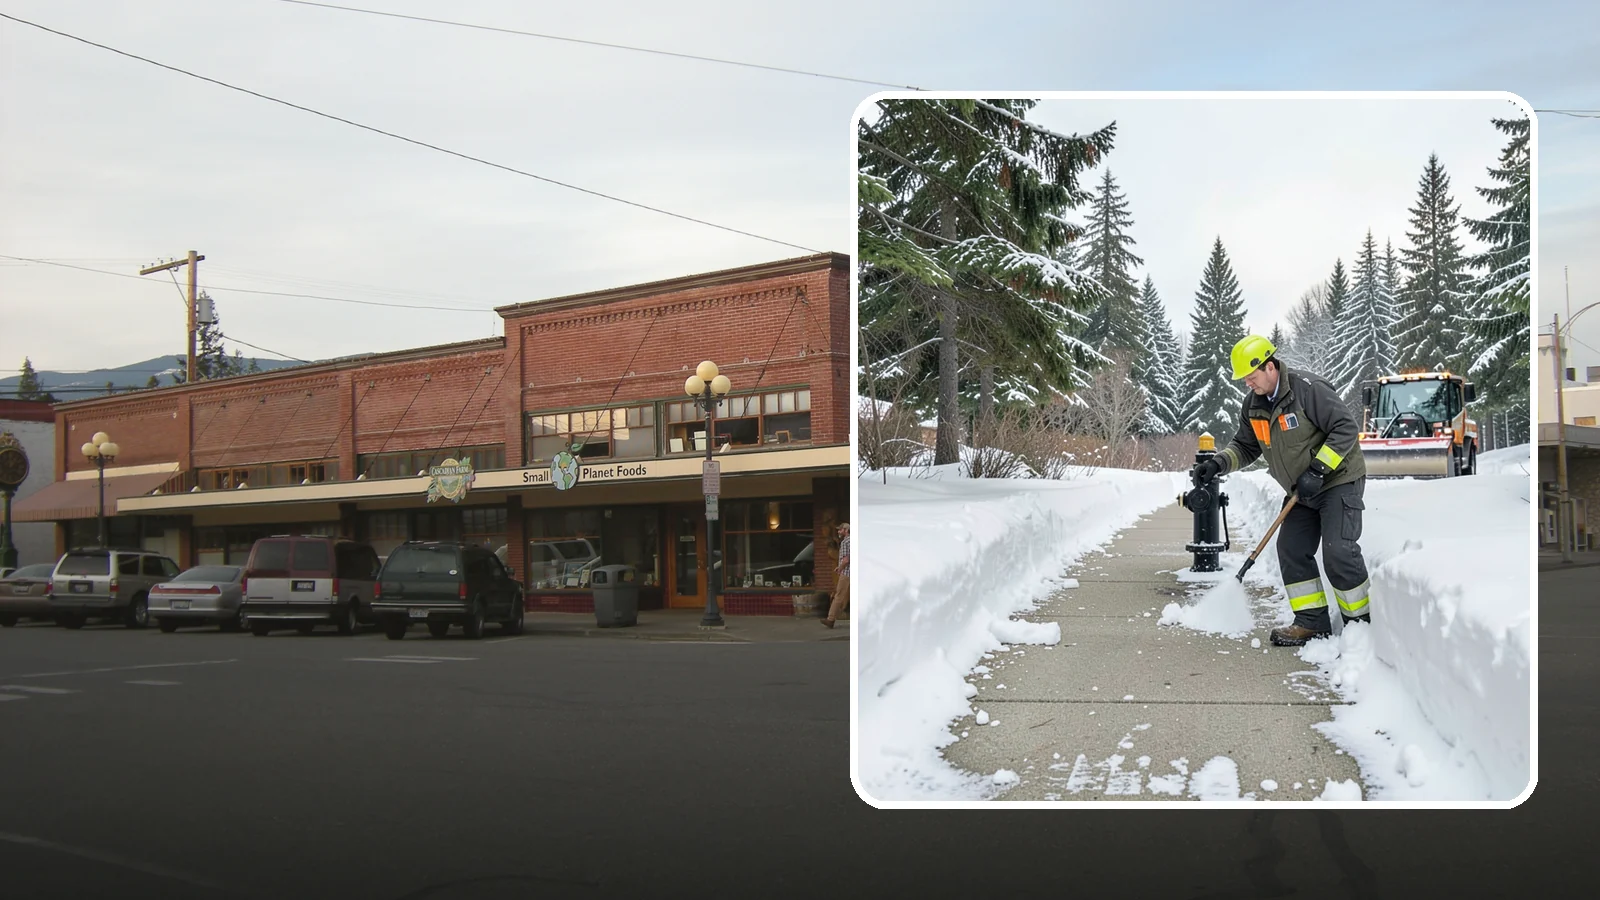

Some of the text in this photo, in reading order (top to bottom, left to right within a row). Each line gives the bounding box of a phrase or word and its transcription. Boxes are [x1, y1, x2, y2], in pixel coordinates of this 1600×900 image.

[432, 467, 455, 476] CASCADIAN
[523, 464, 647, 483] Small Planet Foods
